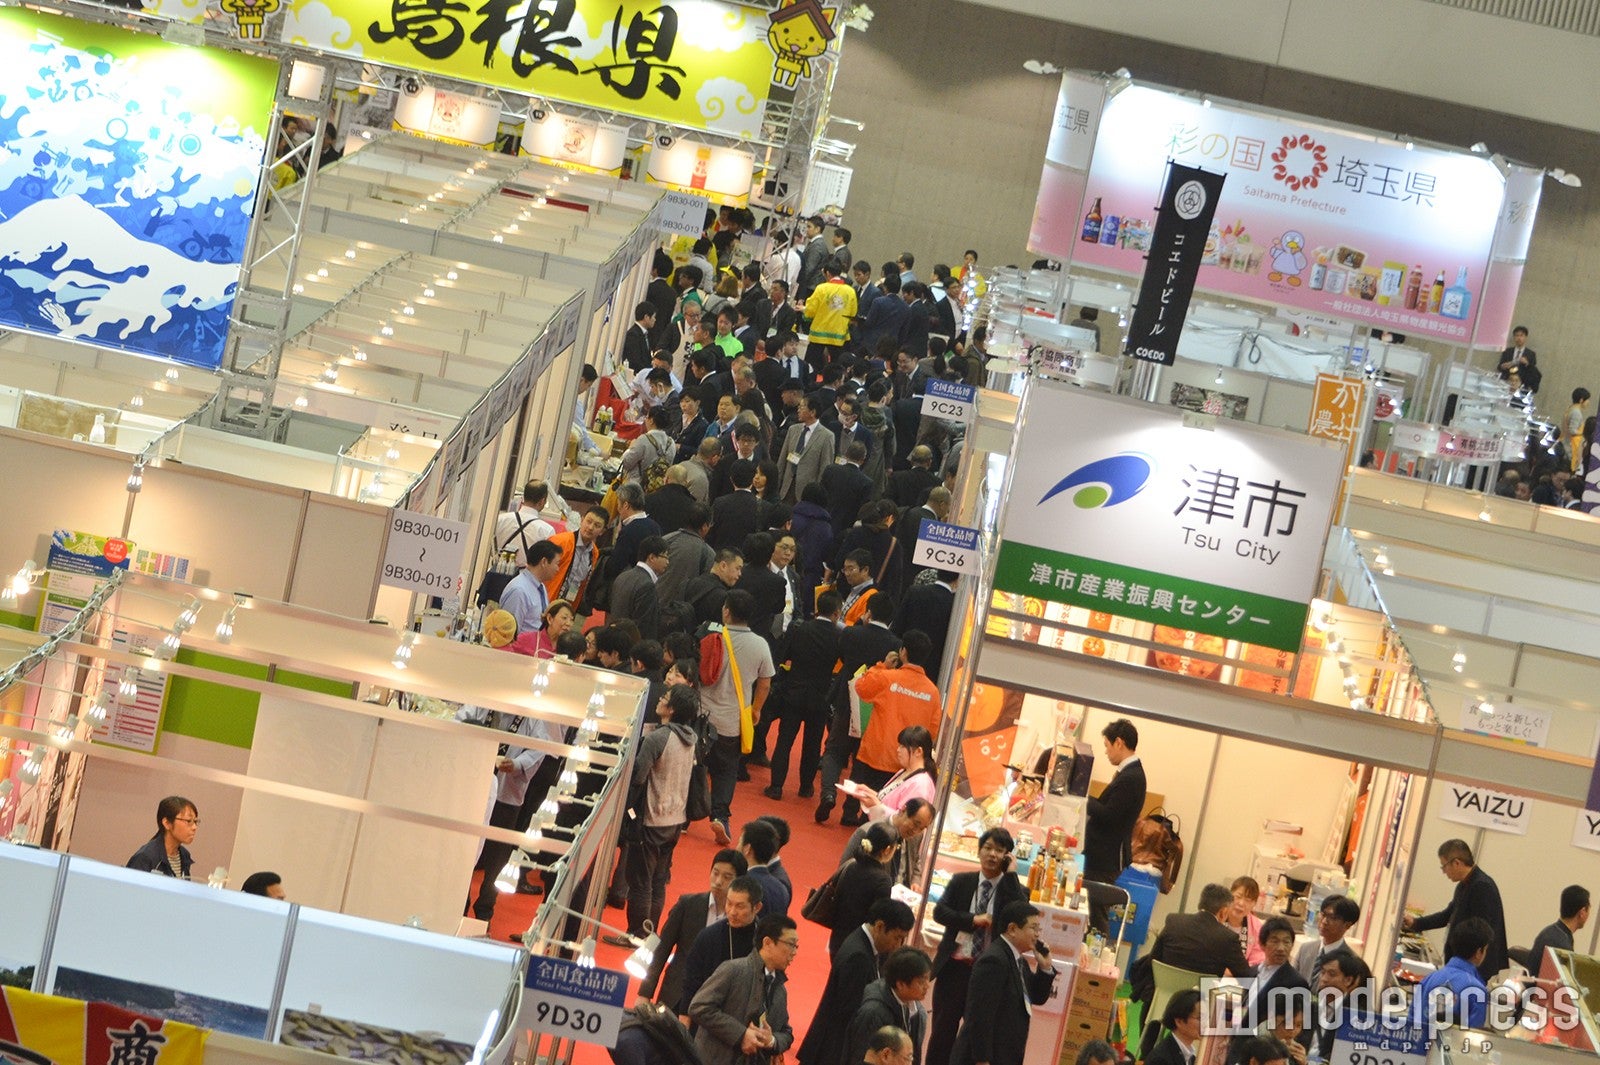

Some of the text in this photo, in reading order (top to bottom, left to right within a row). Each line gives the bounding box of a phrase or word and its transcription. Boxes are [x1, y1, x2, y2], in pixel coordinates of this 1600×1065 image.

[1332, 155, 1437, 207] 埼玉県
[667, 194, 705, 209] 9B30-001
[1243, 185, 1348, 216] Saitama Prefecture
[662, 219, 700, 235] 9B30-013
[1148, 234, 1185, 336] コエドビール
[1135, 346, 1166, 361] COEDO
[931, 401, 963, 417] 9C23
[1173, 463, 1307, 538] 津市
[393, 518, 460, 544] 9B30-001
[927, 523, 975, 542] 全国食品博
[926, 547, 965, 567] 9C36
[1181, 526, 1281, 566] Tsu City
[385, 564, 452, 589] 9B30-013
[1028, 561, 1271, 626] 津市産業振興センター
[1468, 703, 1544, 728] 食っと新しく!
[1452, 787, 1524, 819] YAIZU
[537, 960, 619, 993] 全国食品博
[536, 1001, 602, 1034] 9D30
